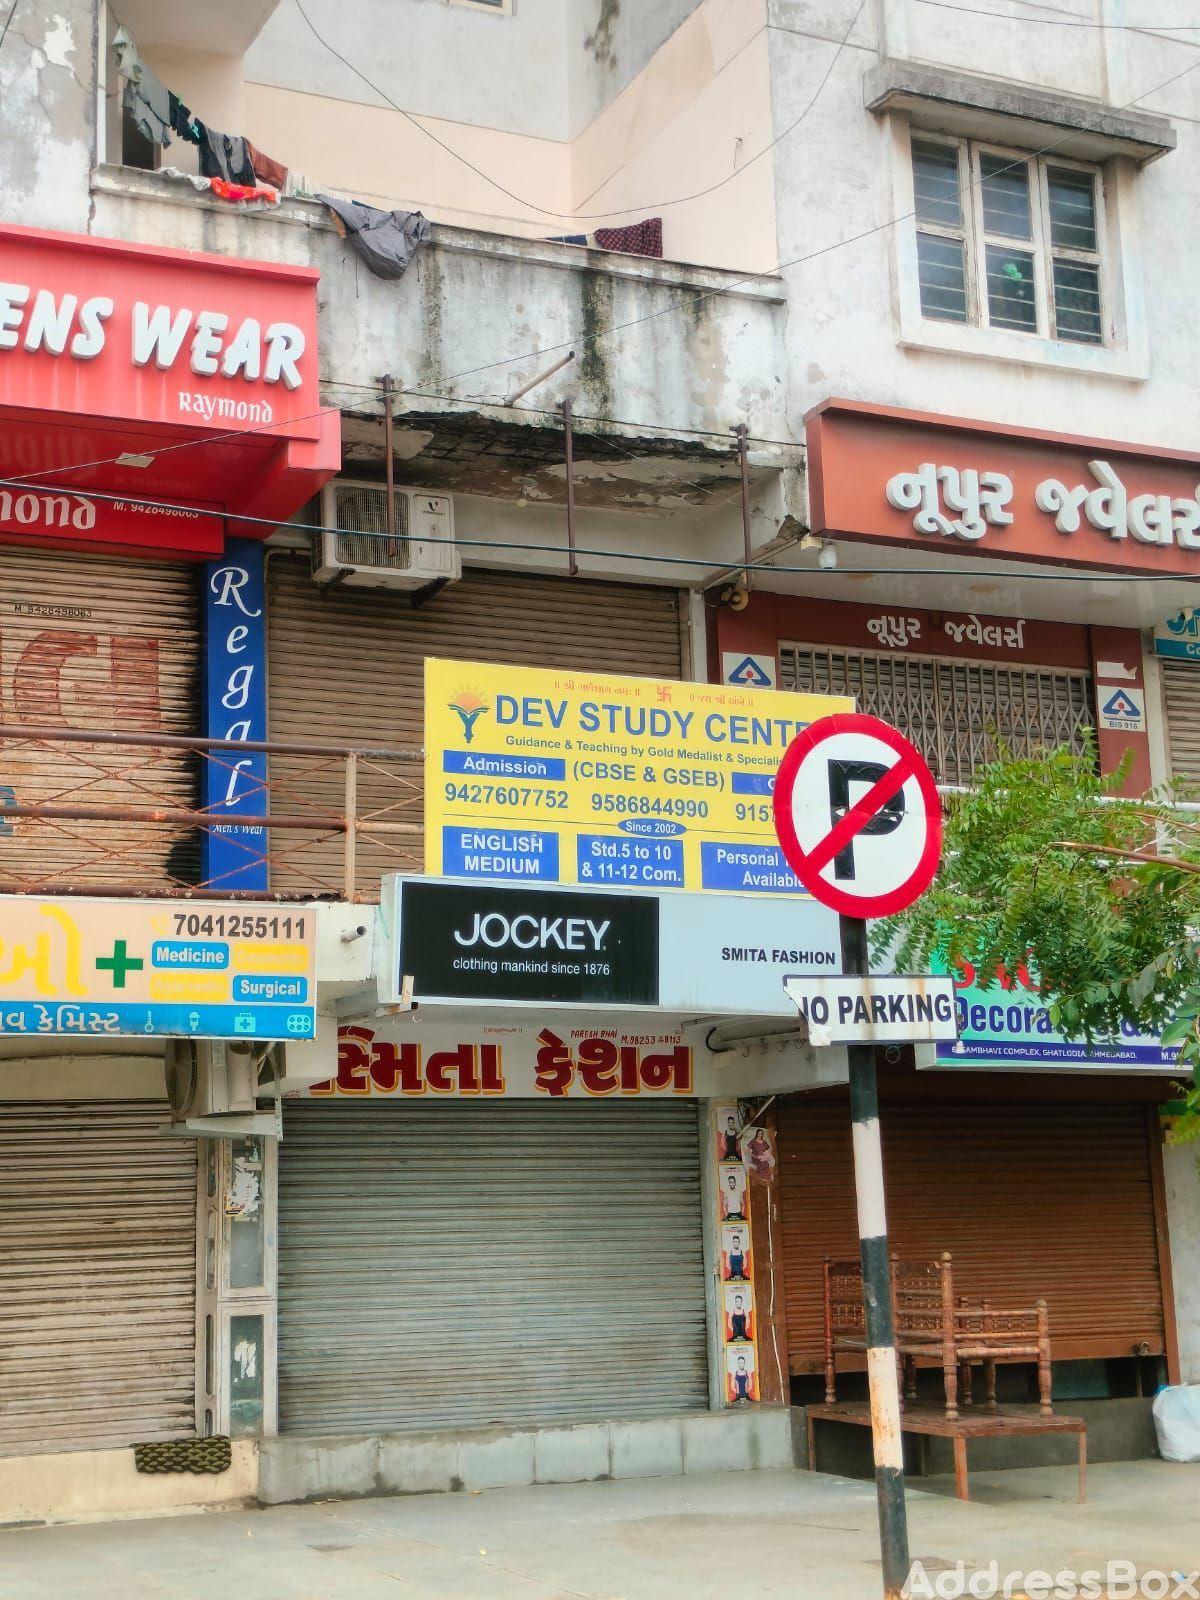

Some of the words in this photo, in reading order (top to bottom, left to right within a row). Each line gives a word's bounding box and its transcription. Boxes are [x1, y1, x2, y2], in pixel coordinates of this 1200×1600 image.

[131, 301, 306, 390] WEAR
[177, 391, 273, 424] Raymond
[886, 462, 1014, 541] નૂપુર
[866, 615, 921, 648] નૂપુર
[210, 565, 262, 807] Regal
[496, 694, 568, 729] DEV
[579, 702, 695, 739] STUDY
[505, 735, 561, 750] Guidance
[564, 739, 573, 750] &
[576, 740, 628, 757] Teaching
[631, 746, 645, 759] by
[647, 746, 675, 758] Gold
[677, 748, 723, 763] Medalist
[726, 753, 734, 763] &
[737, 753, 783, 767] Speciali
[463, 756, 547, 776] Admission
[573, 760, 636, 782] (CBSE
[643, 766, 657, 782] &
[662, 766, 726, 792] GSEB)
[444, 782, 569, 809] 9427607752
[591, 793, 709, 819] 9586844990
[625, 821, 652, 833] Since
[654, 823, 677, 834] 2002
[827, 759, 906, 880] P
[461, 833, 543, 853] ENGLISH
[591, 841, 631, 858] Std.5
[634, 844, 650, 860] to
[654, 845, 672, 860] 10
[717, 848, 779, 867] Personal
[464, 855, 540, 874] MEDIUM
[581, 861, 593, 877] &
[598, 862, 638, 880] 11-12
[642, 866, 682, 882] Com.
[173, 913, 305, 939] 7041255111
[454, 912, 610, 951] JOCKEY
[156, 946, 225, 963] Medicine
[453, 957, 498, 973] clothing
[501, 960, 548, 974] mankind
[551, 961, 580, 975] since
[583, 963, 610, 976] 1876
[721, 947, 768, 962] SMITA
[772, 949, 836, 965] FASHION
[240, 979, 301, 998] Surgical
[33, 1003, 121, 1032] કેમિસ્ટ
[837, 993, 951, 1025] PARKING
[534, 1028, 694, 1097] ફેશન
